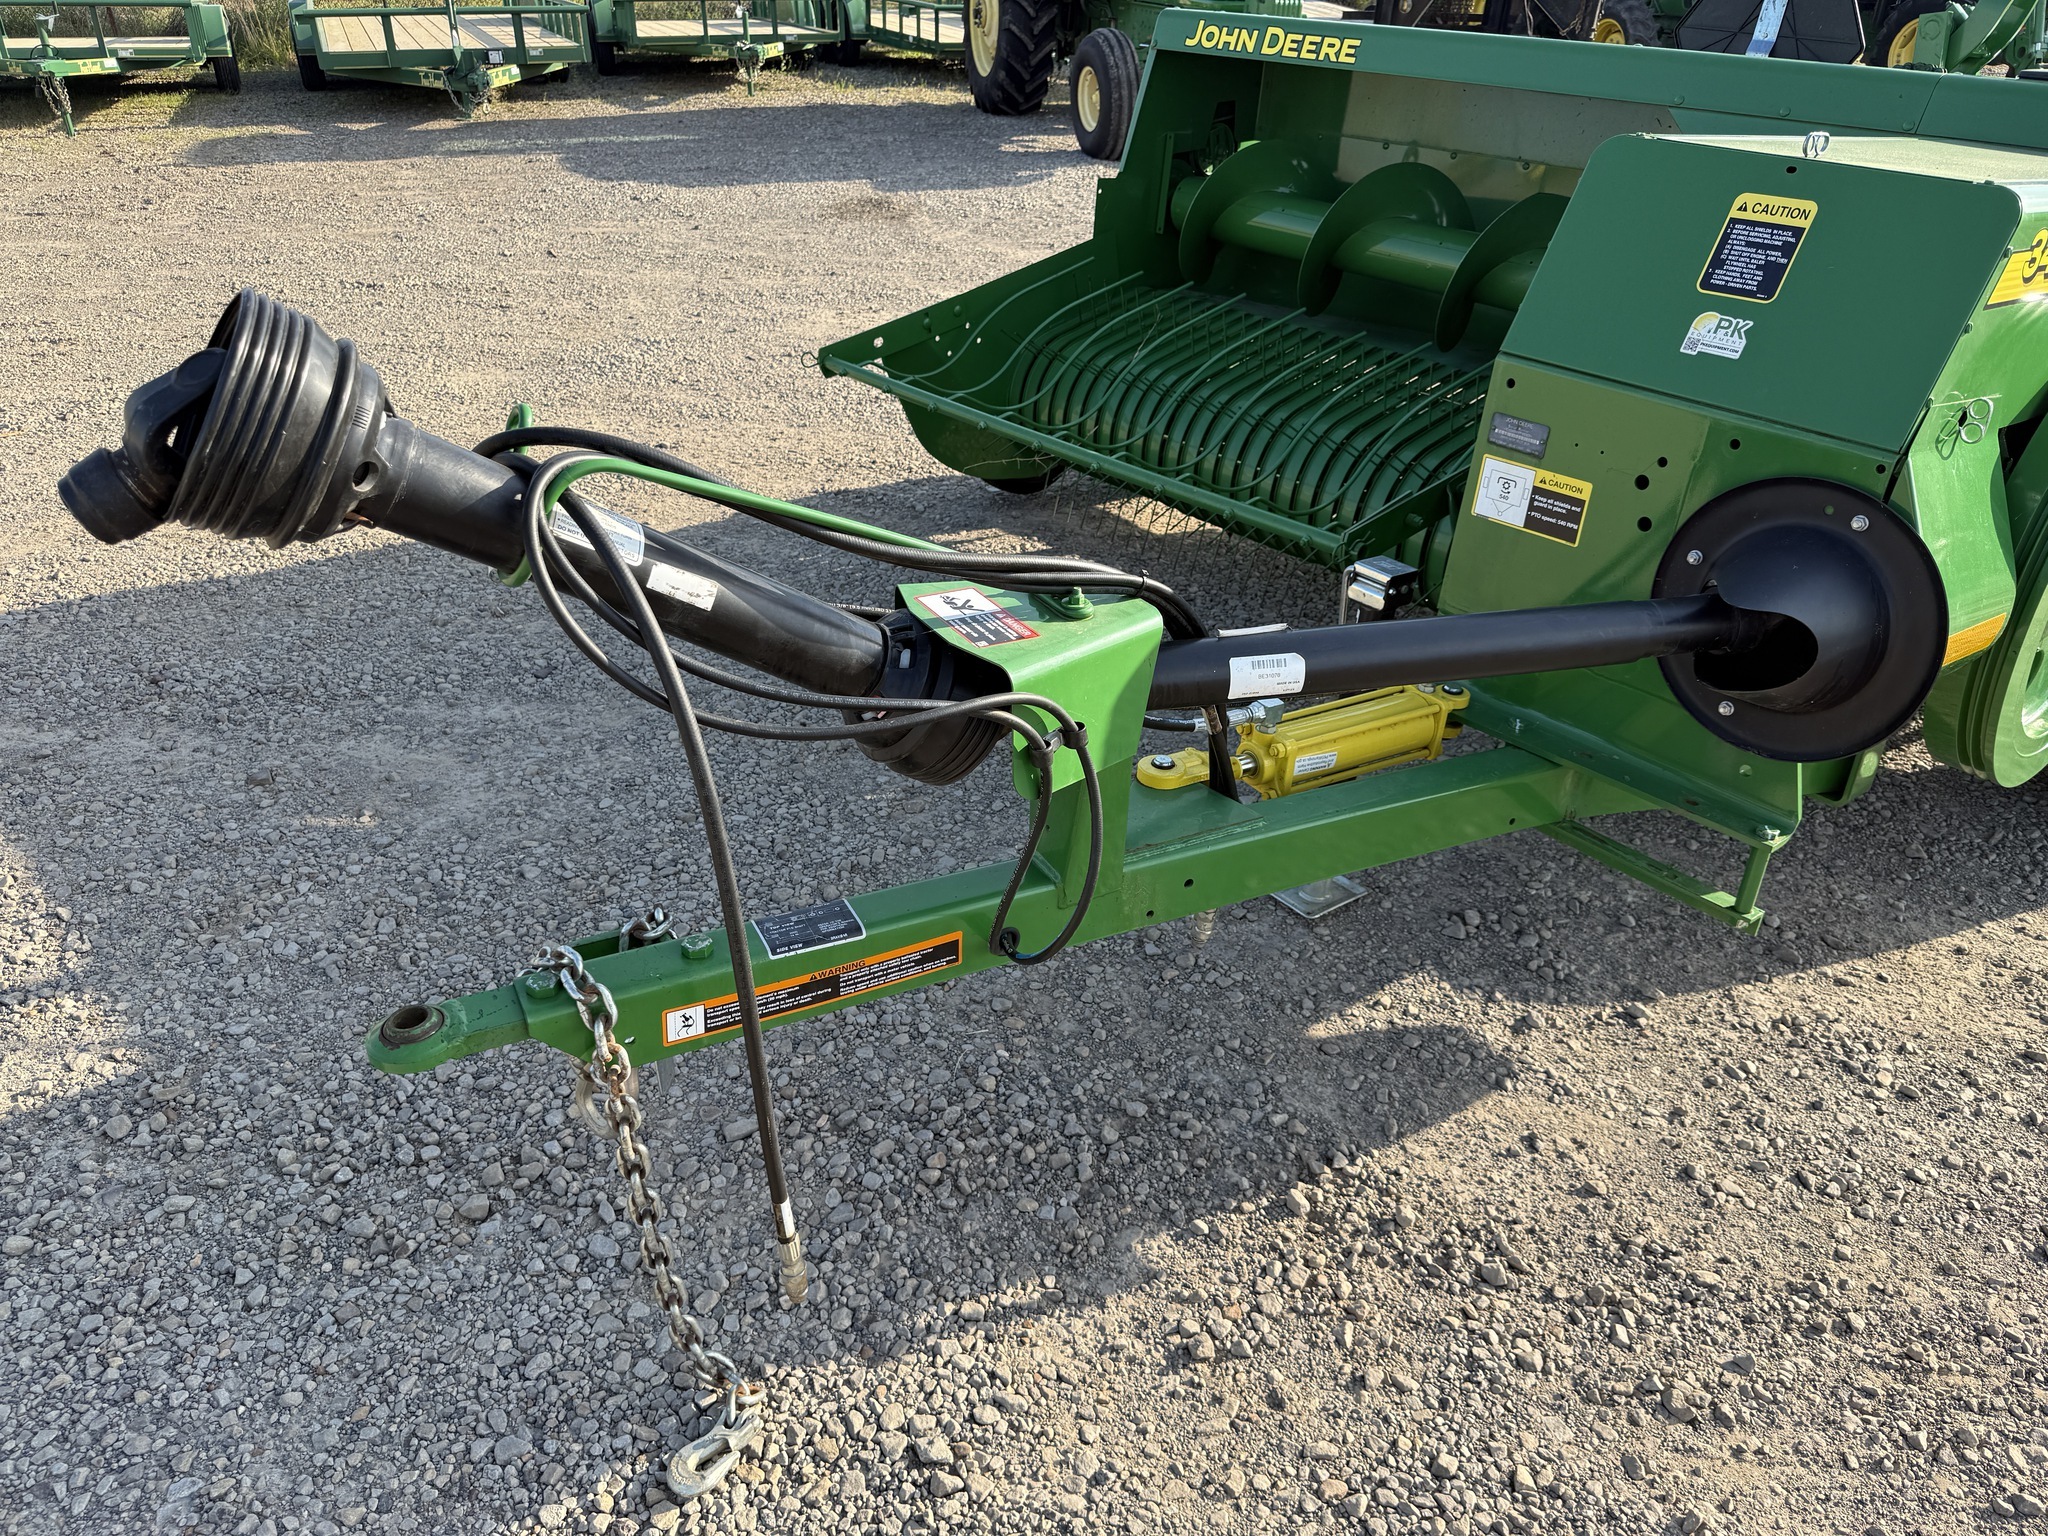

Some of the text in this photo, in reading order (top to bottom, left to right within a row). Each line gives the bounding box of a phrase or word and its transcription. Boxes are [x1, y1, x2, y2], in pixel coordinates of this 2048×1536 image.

[1185, 20, 1362, 64] JOHN DEERE
[1752, 202, 1811, 220] CAUTION
[1690, 331, 1742, 346] EQUIPMENT
[1548, 480, 1584, 495] CAUTION
[1499, 493, 1509, 501] 540
[1535, 495, 1547, 503] Keep
[1554, 500, 1571, 509] shields
[1533, 501, 1547, 509] guard
[1552, 507, 1567, 515] place.
[1541, 515, 1557, 524] speed:
[884, 958, 900, 966] properly
[818, 960, 866, 979] WARNING
[855, 974, 873, 983] transport
[778, 986, 799, 994] maximum
[707, 1009, 728, 1018] transport
[707, 1014, 731, 1024] Exceeding
[707, 1019, 728, 1028] transport
